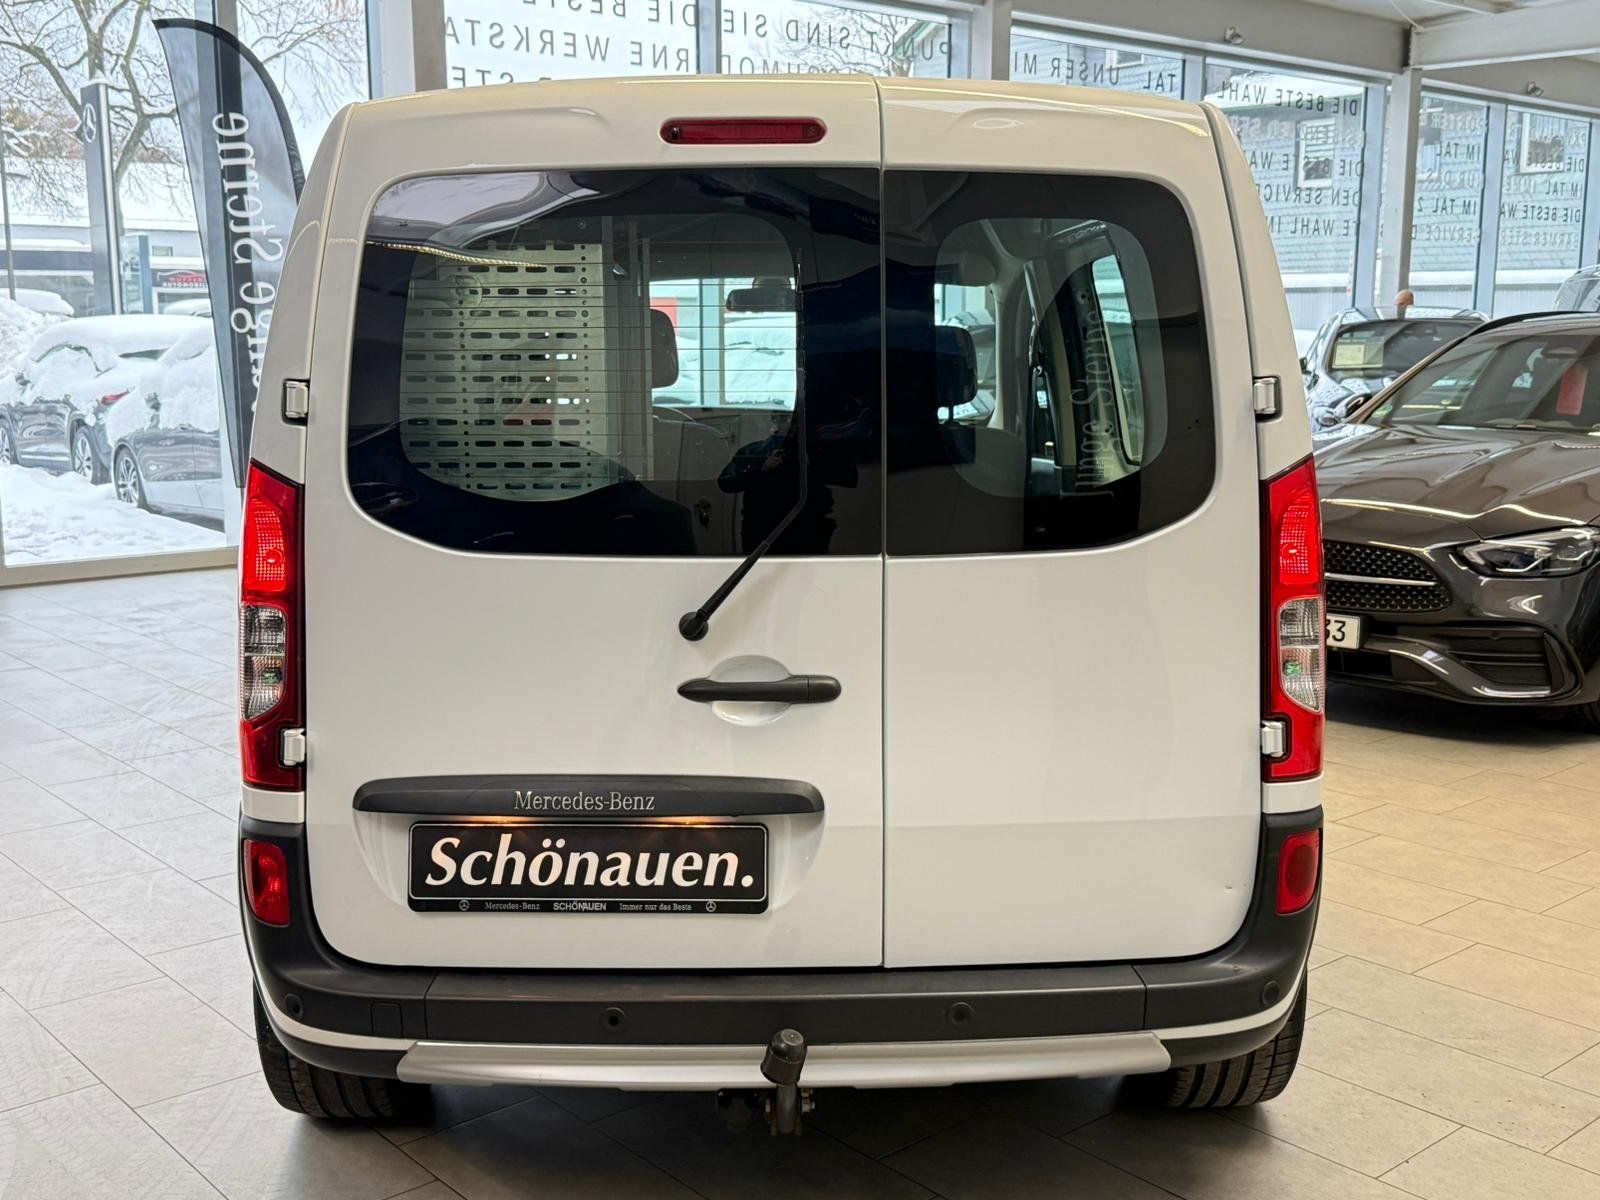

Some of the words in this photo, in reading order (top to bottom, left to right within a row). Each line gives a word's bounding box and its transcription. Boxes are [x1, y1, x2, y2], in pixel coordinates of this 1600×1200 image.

[513, 790, 656, 812] Mercedes-Benz
[424, 833, 754, 888] Schönauen.
[484, 902, 541, 911] Mercedes-Benz
[553, 900, 607, 912] SCHÖNAUEN
[619, 903, 643, 911] Immer
[658, 903, 671, 911] das
[672, 903, 692, 911] Beste
